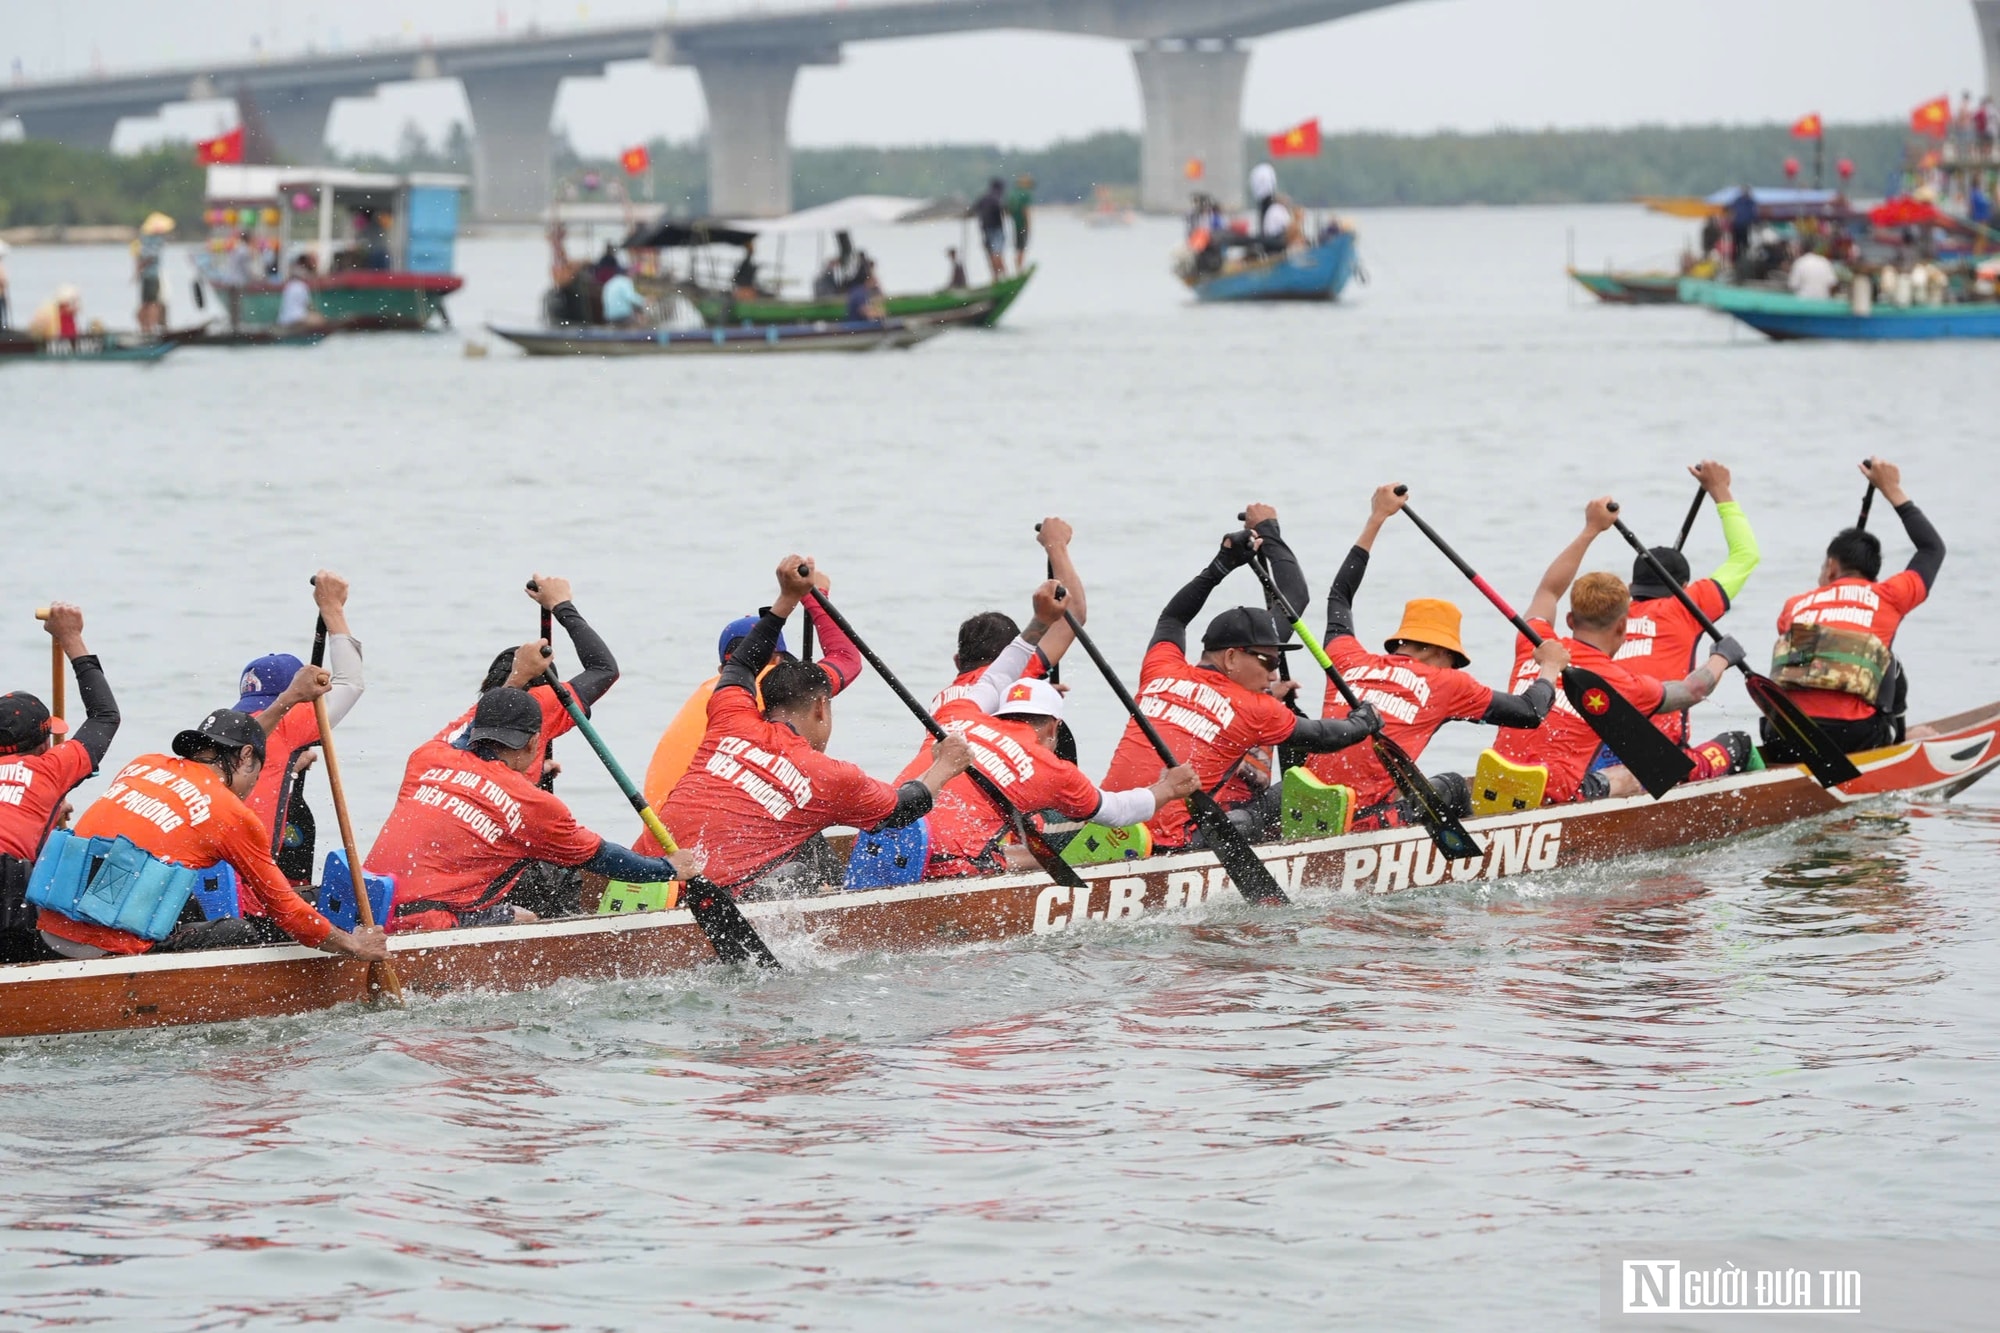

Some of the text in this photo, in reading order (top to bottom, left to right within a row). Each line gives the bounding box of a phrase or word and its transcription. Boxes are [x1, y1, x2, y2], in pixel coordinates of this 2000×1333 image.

[419, 768, 455, 782] CLB
[413, 784, 505, 844] ĐIỆN PHƯƠNG
[1033, 877, 1147, 935] CLB
